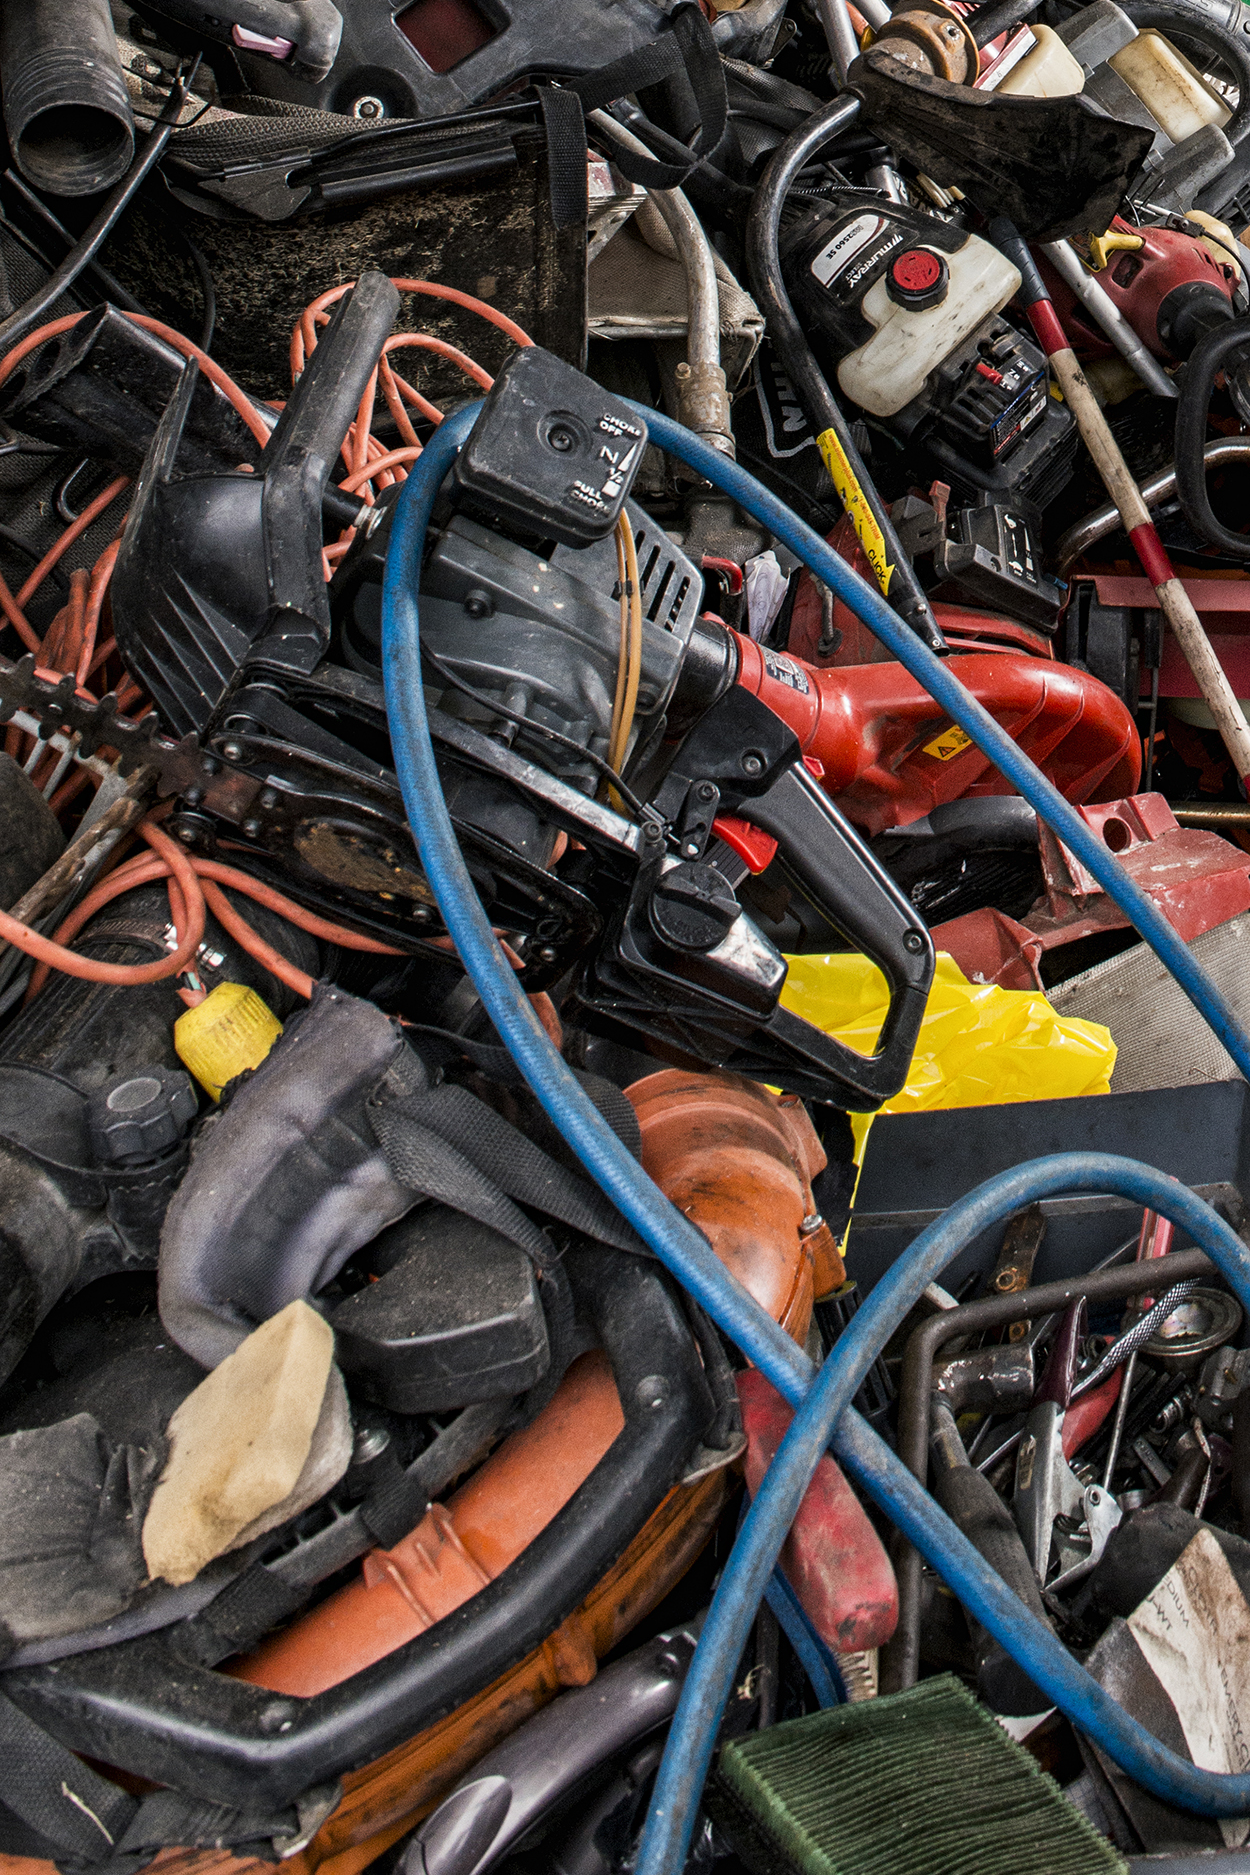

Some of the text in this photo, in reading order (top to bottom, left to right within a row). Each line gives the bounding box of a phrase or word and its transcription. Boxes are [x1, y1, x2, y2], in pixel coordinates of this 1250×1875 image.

[825, 249, 838, 261] SE
[845, 239, 894, 289] MURRAY
[599, 421, 624, 436] OFF
